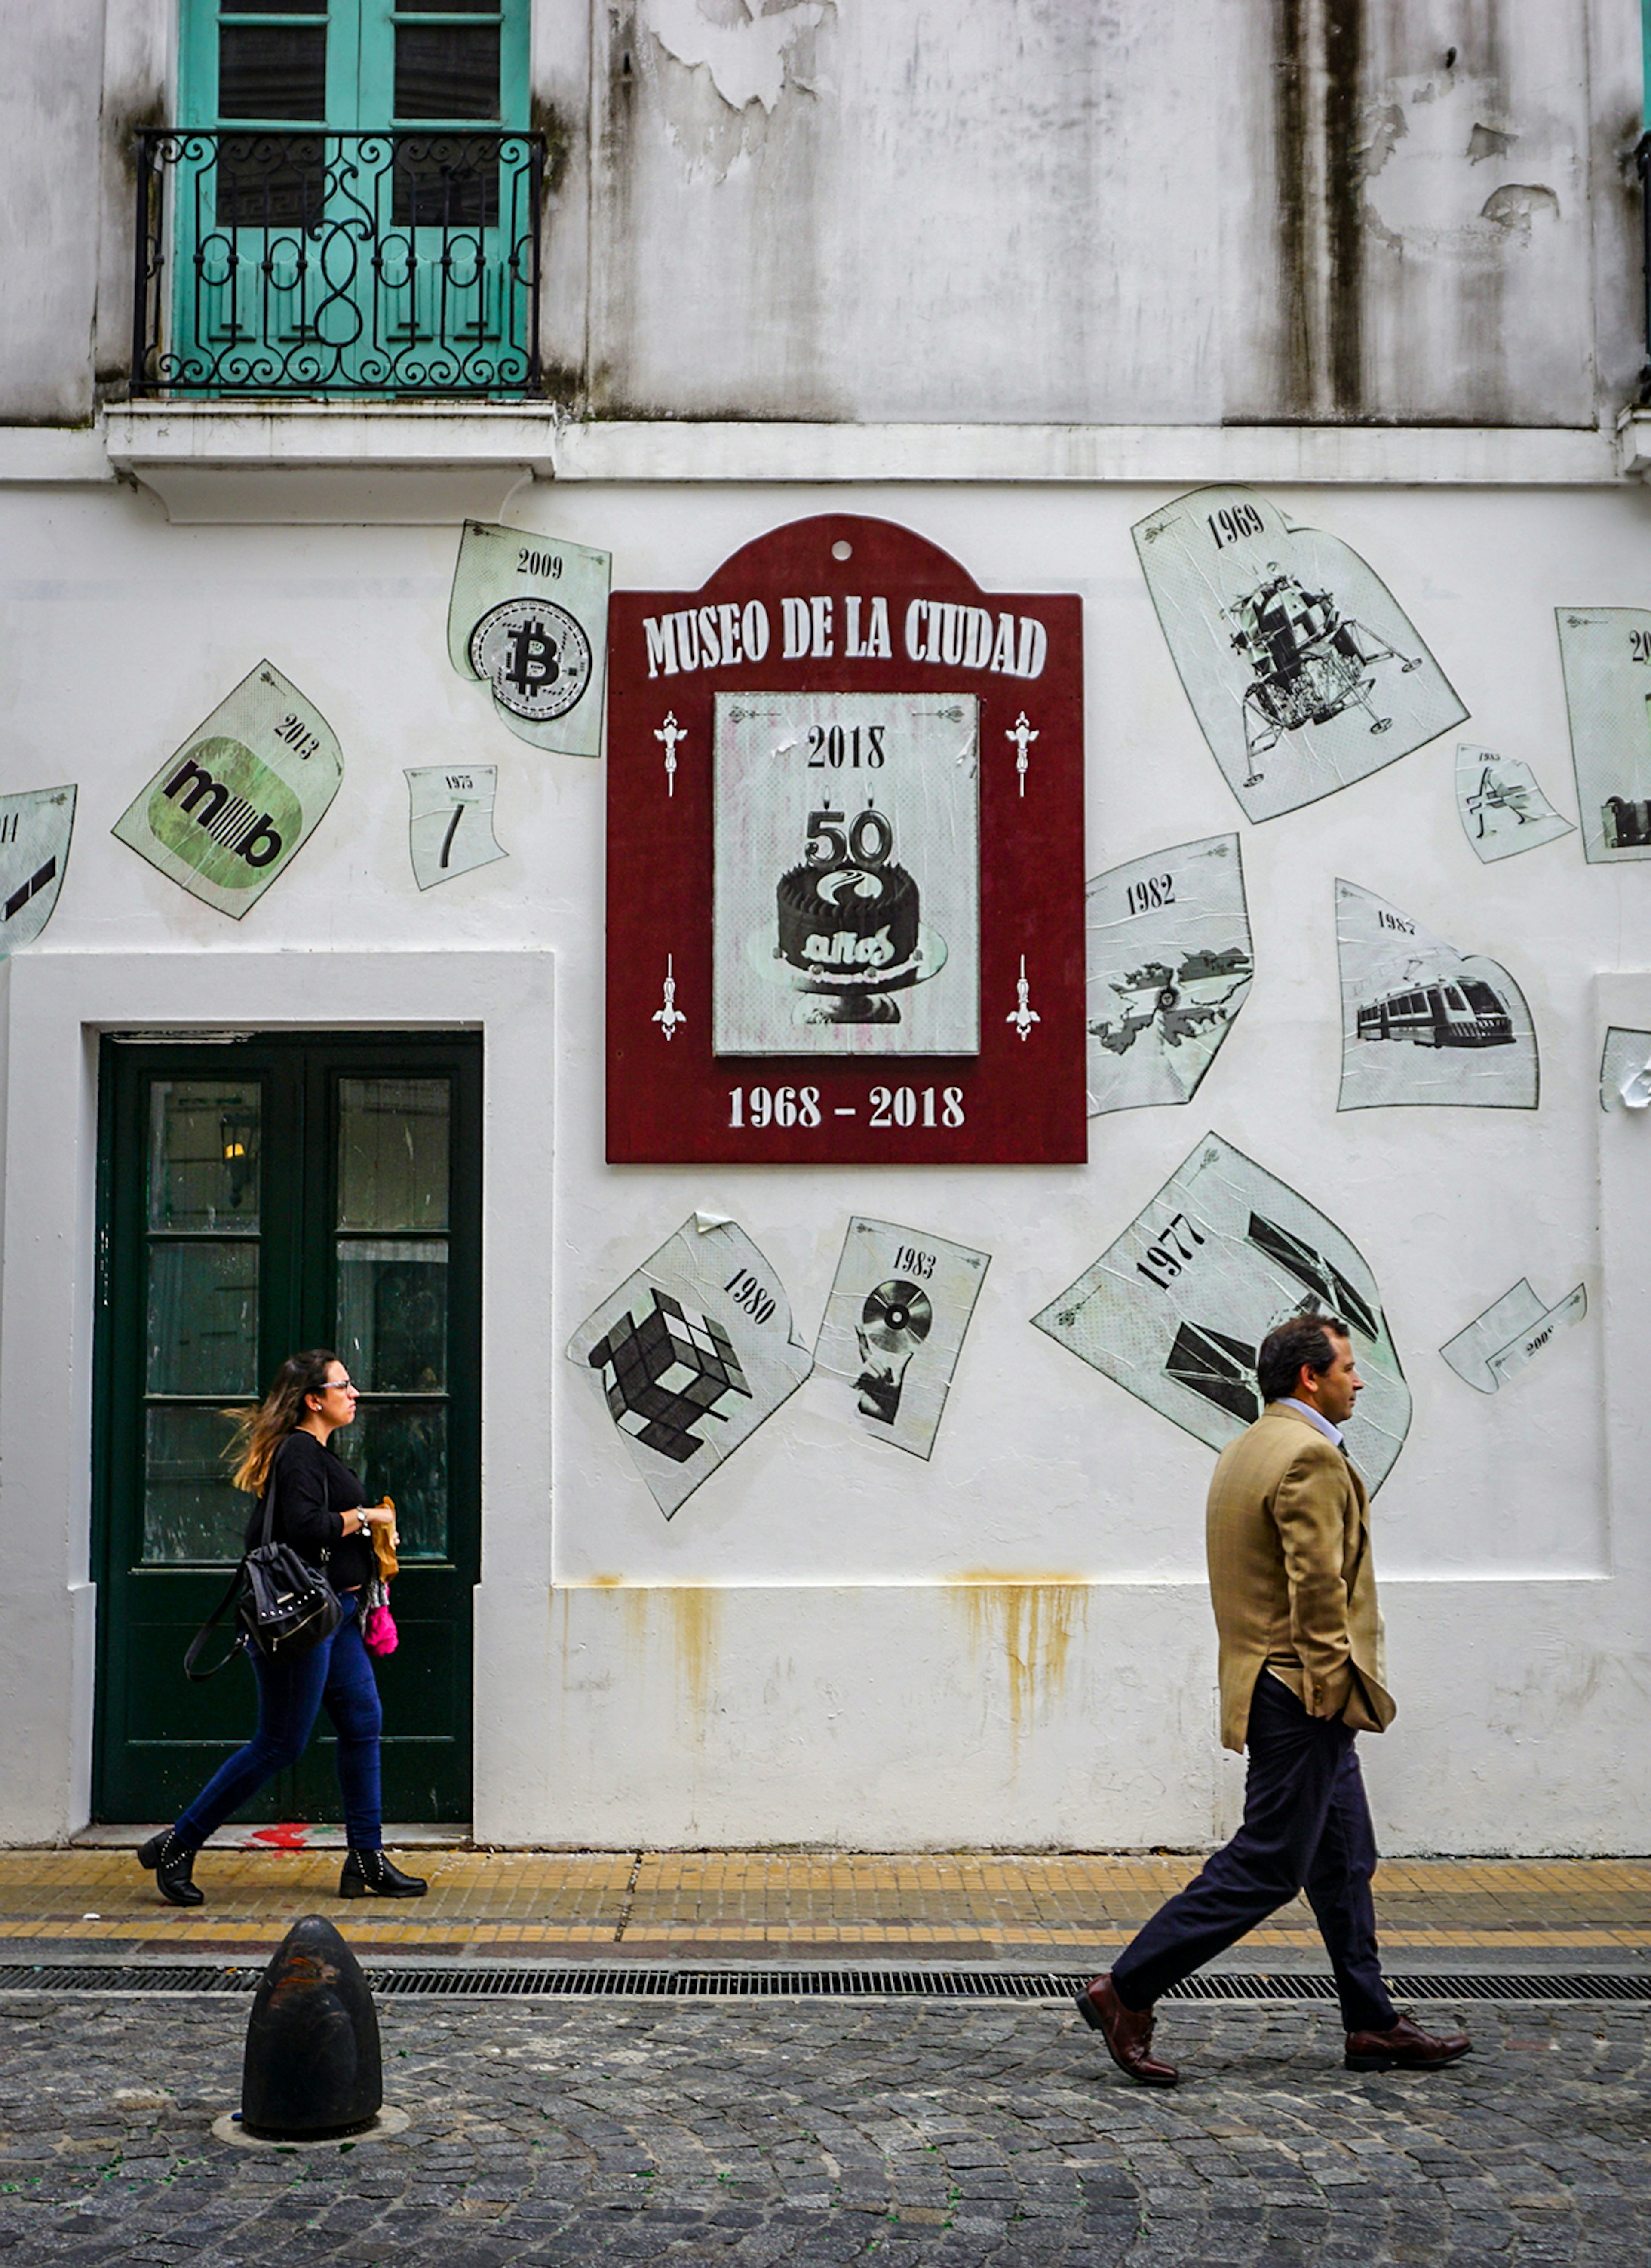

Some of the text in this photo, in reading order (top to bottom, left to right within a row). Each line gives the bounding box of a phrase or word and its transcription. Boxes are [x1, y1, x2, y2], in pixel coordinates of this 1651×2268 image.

[1206, 503, 1264, 549] 1969
[517, 548, 562, 579] 2009
[642, 599, 770, 678] MUSEO
[781, 596, 834, 659] DE
[844, 596, 893, 658] LA
[905, 599, 1048, 680] CIUDAD
[274, 713, 319, 760] 2013
[807, 725, 886, 769] 2018
[445, 775, 473, 789] 1975
[805, 810, 893, 865] 50
[1127, 873, 1175, 915] 1982
[1378, 910, 1415, 936] 1987
[727, 1086, 821, 1128] 1968
[868, 1086, 965, 1128] 2018
[894, 1246, 936, 1280] 1983
[1136, 1213, 1205, 1291] 1977
[724, 1268, 776, 1325] 1980
